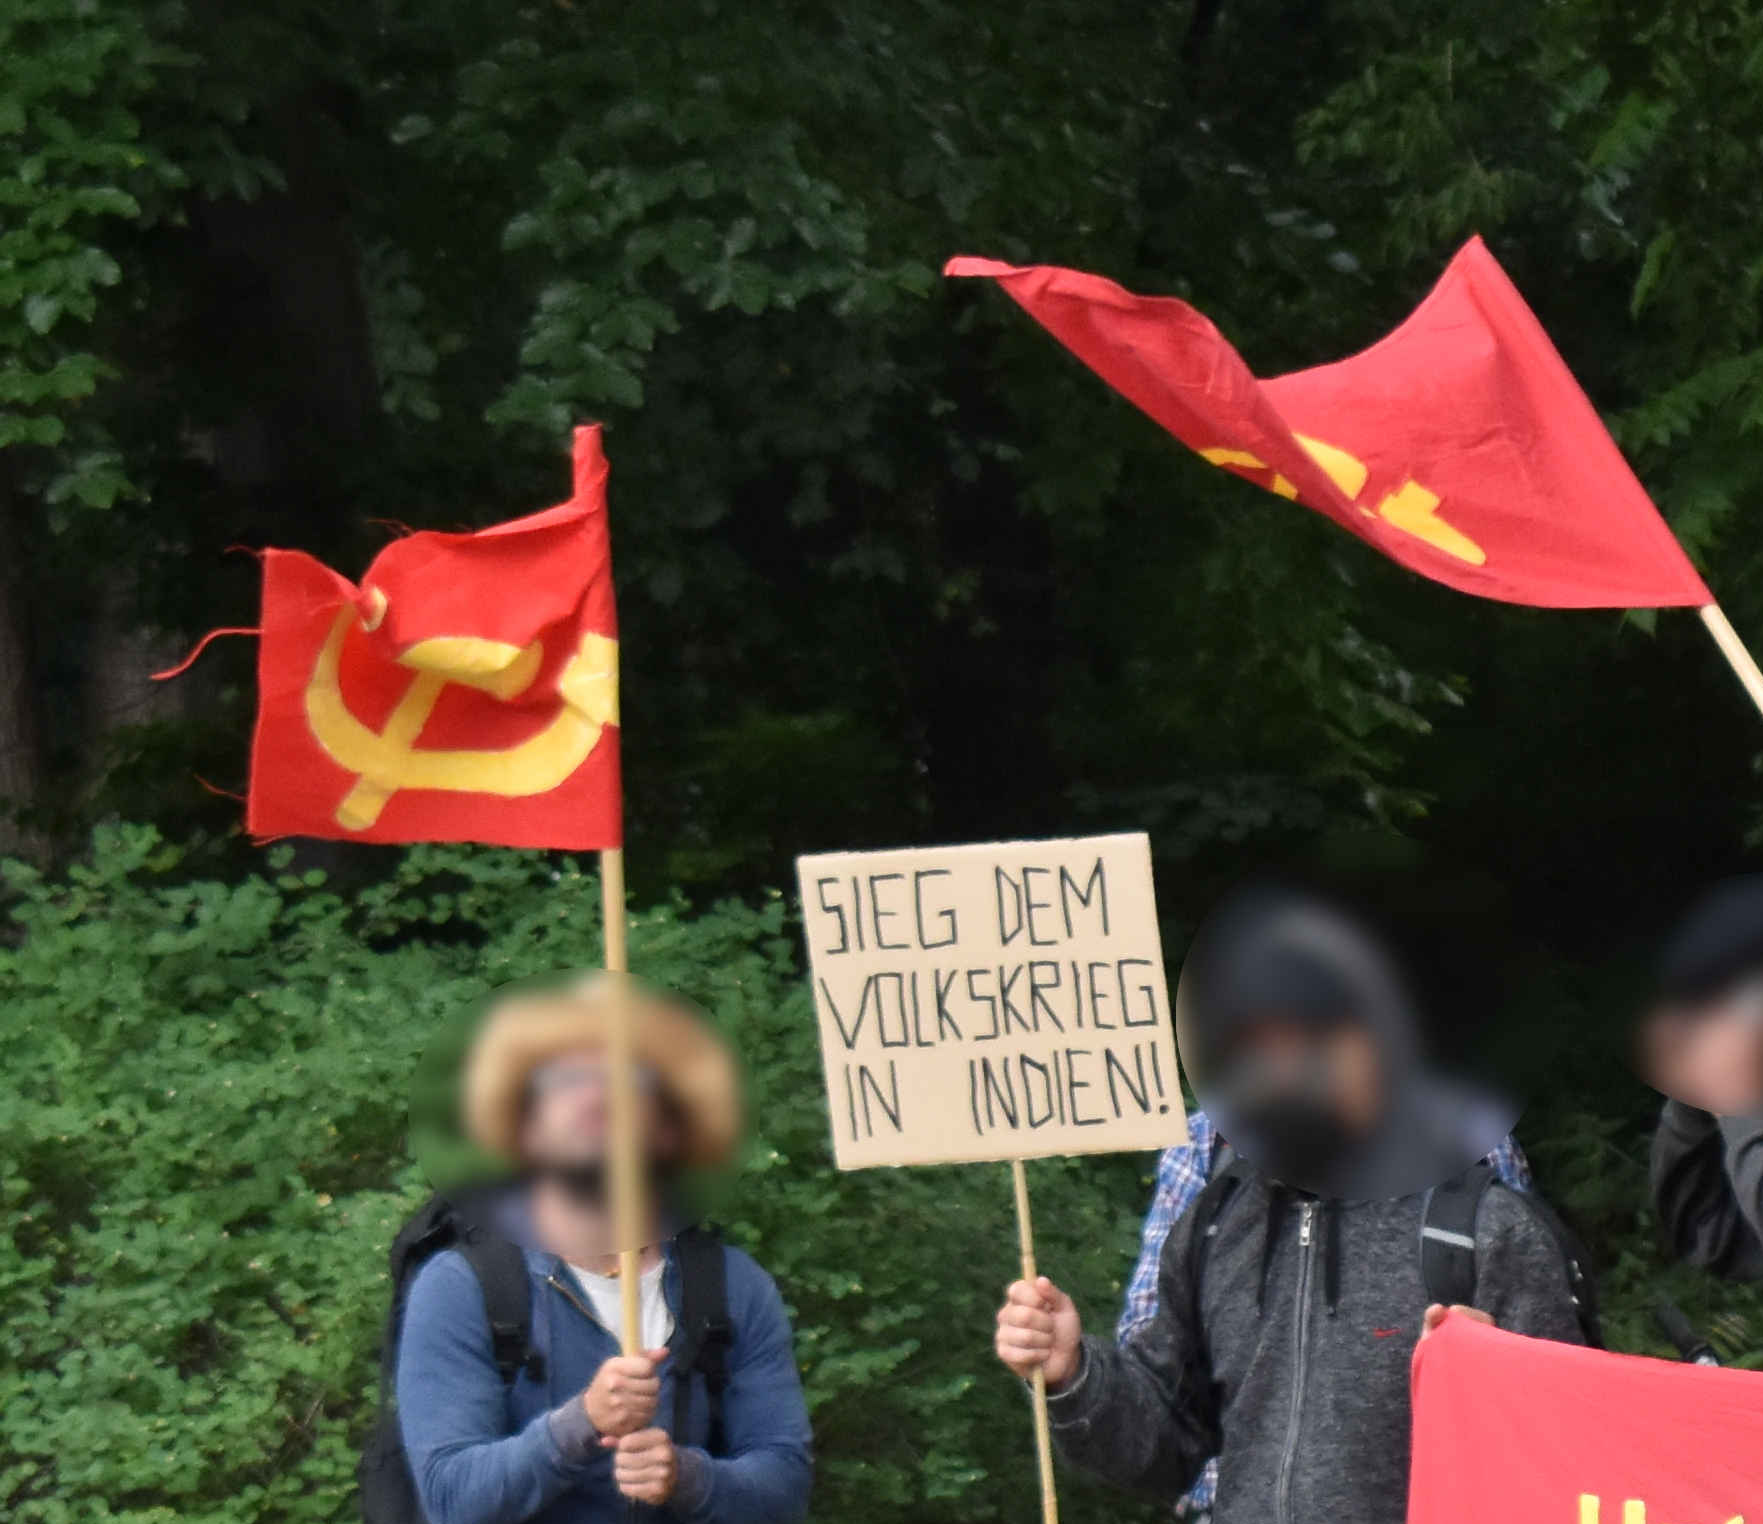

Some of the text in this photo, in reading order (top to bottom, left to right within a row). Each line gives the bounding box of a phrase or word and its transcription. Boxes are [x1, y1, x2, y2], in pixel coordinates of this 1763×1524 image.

[817, 856, 1110, 955] SIEG DEM
[819, 958, 1159, 1050] VOLKSKRIEG
[845, 1040, 1172, 1142] IN INDIEN!
